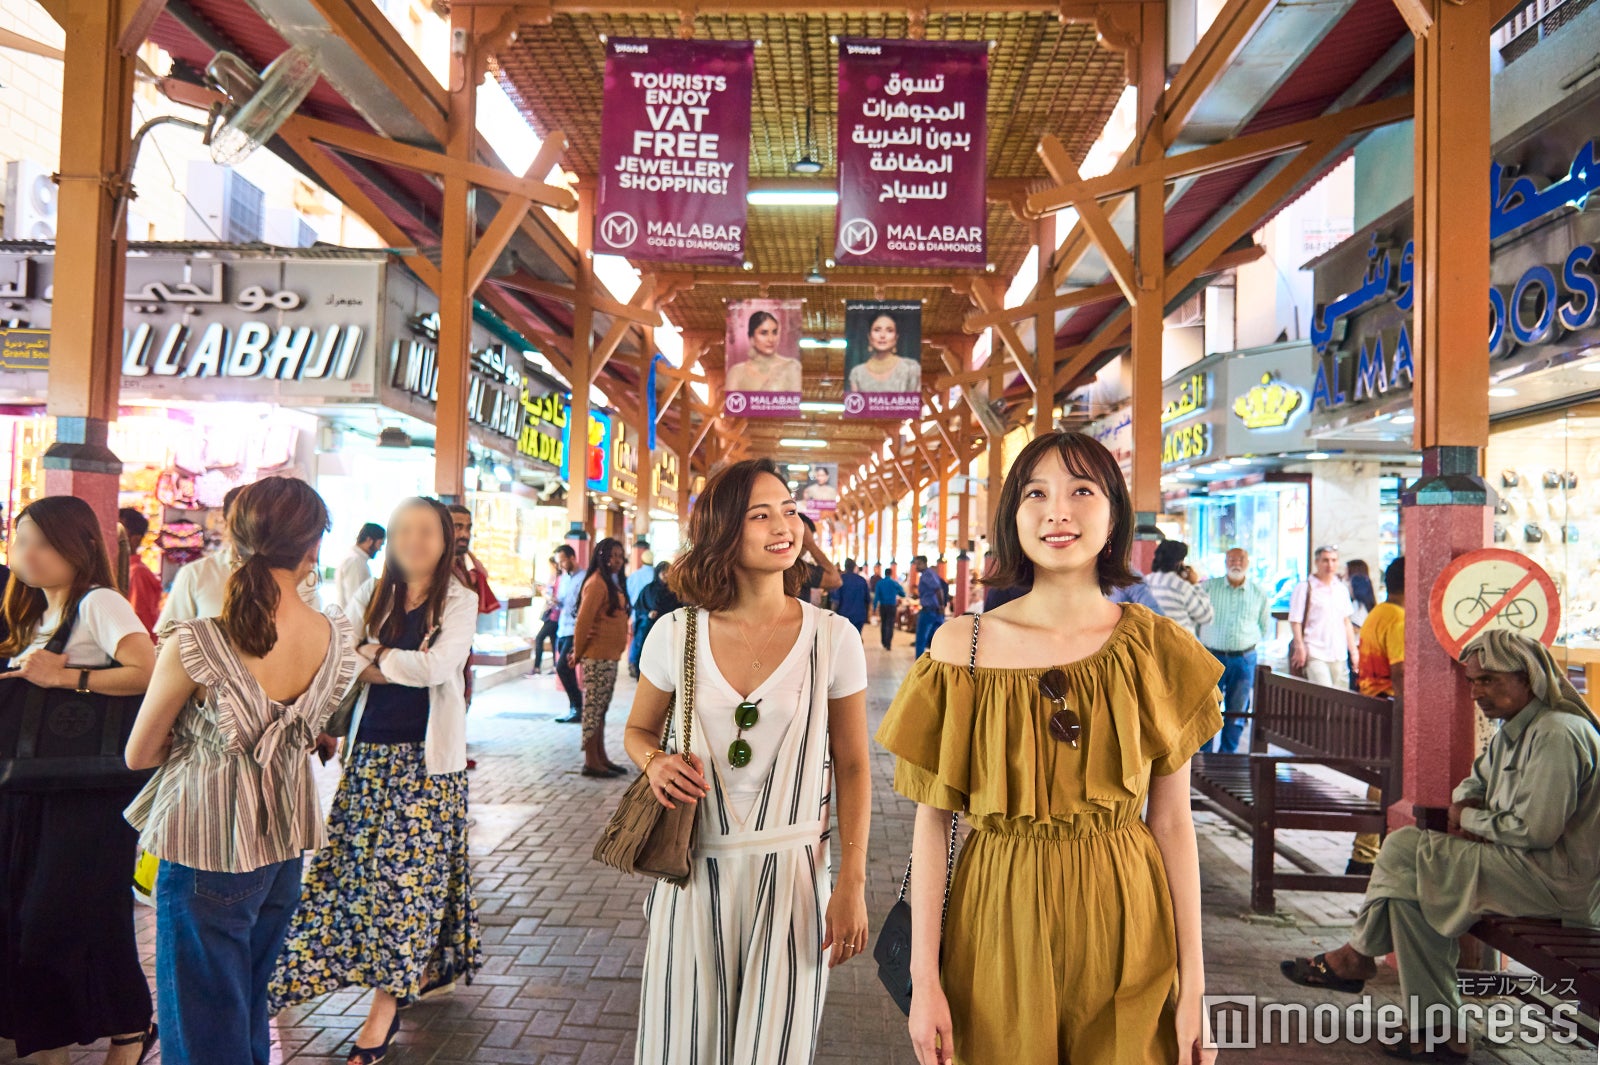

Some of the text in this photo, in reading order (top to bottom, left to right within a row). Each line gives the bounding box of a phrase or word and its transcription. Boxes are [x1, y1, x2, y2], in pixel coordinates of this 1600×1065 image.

[631, 72, 727, 91] TOURISTS
[884, 73, 944, 95] تسوق
[645, 89, 711, 107] ENJOY
[646, 106, 709, 131] VAT
[863, 98, 965, 123] المجوهرات
[633, 130, 719, 159] FREE
[852, 124, 971, 151] بدون الضريبة
[615, 156, 734, 178] JEWELLERY
[870, 152, 952, 174] المضافة
[619, 173, 727, 194] SHOPPING!
[879, 180, 947, 203] للسياح
[647, 220, 741, 241] MALABAR
[887, 224, 983, 242] MALABAR
[647, 237, 740, 252] GOLD & DIAMONDS
[887, 240, 983, 253] GOLD & DIAMONDS
[122, 321, 362, 380] LLABHJI
[404, 340, 438, 402] MUL
[1310, 353, 1345, 413] AL
[1354, 321, 1414, 400] MA
[869, 396, 920, 406] MALABAR
[1161, 422, 1204, 464] ACES
